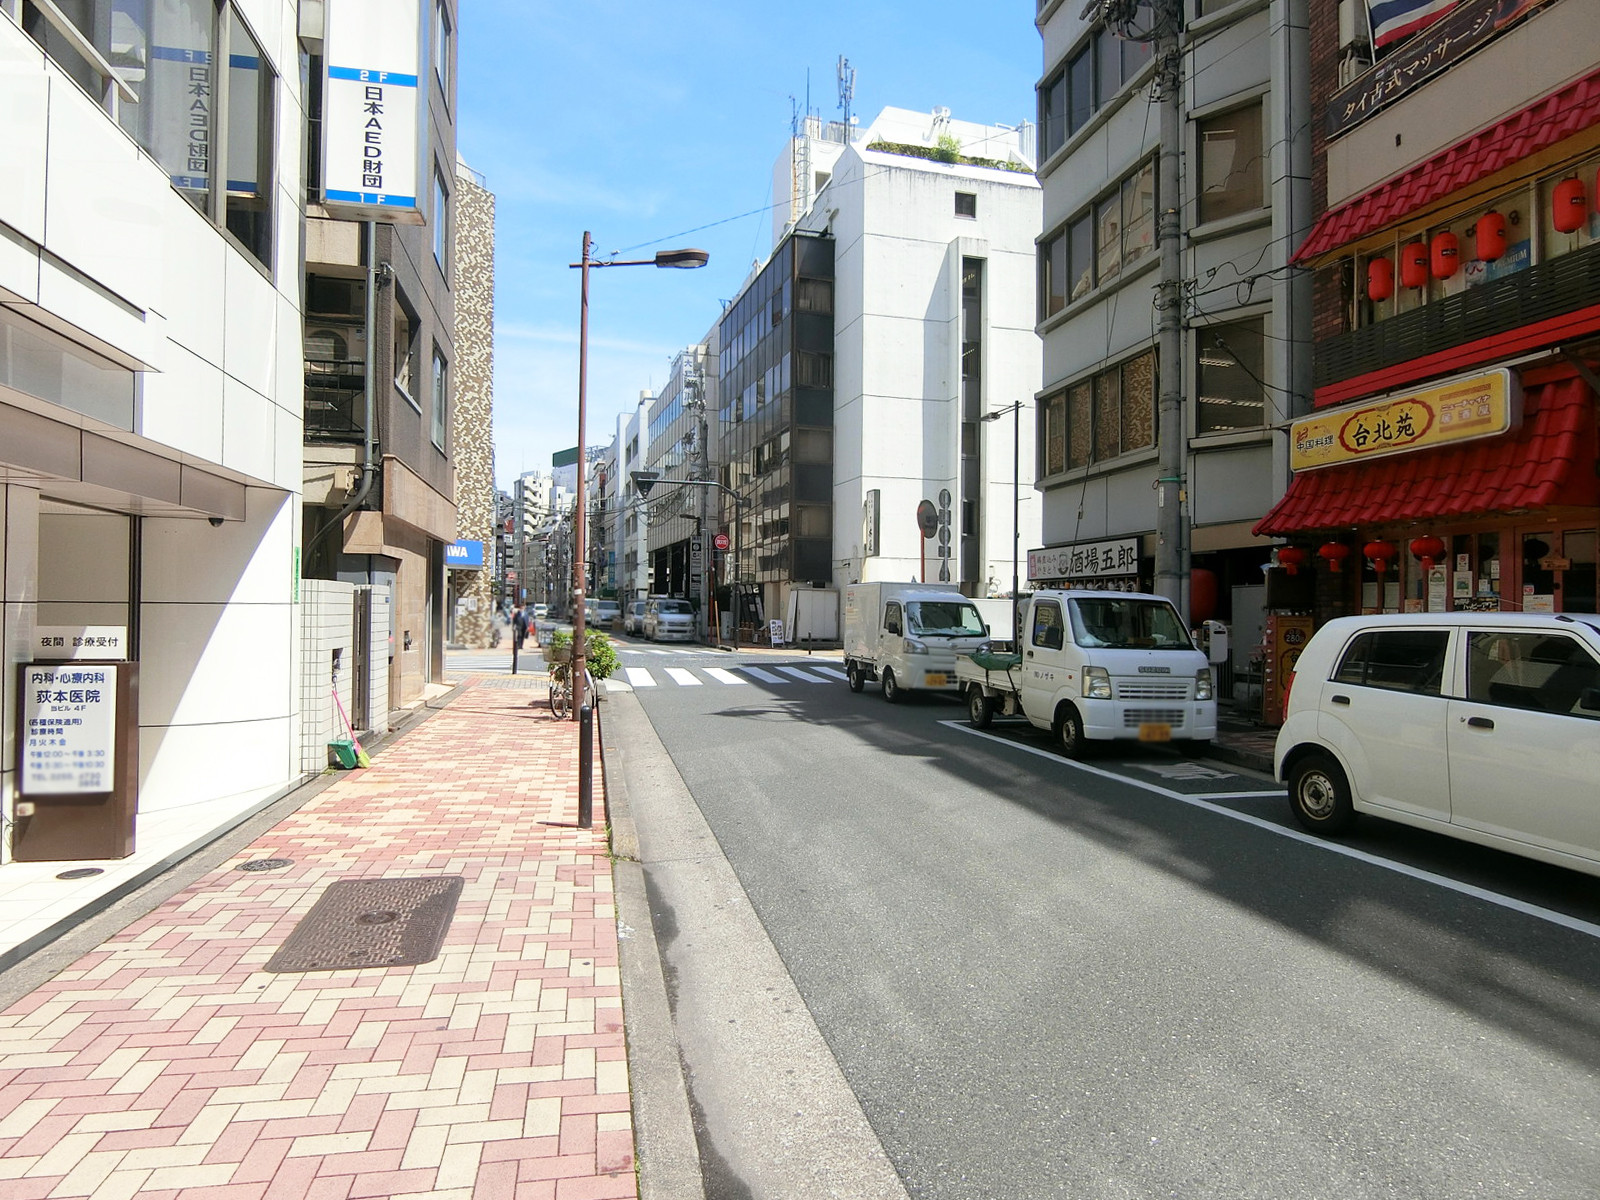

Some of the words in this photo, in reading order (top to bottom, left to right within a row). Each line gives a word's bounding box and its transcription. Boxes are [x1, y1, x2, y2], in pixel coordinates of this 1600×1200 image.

[1342, 8, 1493, 122] タイ古式マッサージ
[359, 70, 388, 83] 2F
[363, 86, 384, 189] 日本AED財団
[359, 193, 387, 205] 1F
[1352, 412, 1416, 448] 台北苑
[1296, 434, 1334, 452] 中国料理
[1070, 545, 1134, 574] 酒場五郎
[41, 637, 64, 647] 夜間
[73, 637, 118, 647] 診療受付
[31, 672, 105, 684] 内科・心療内科
[36, 690, 100, 704] 荻本医院
